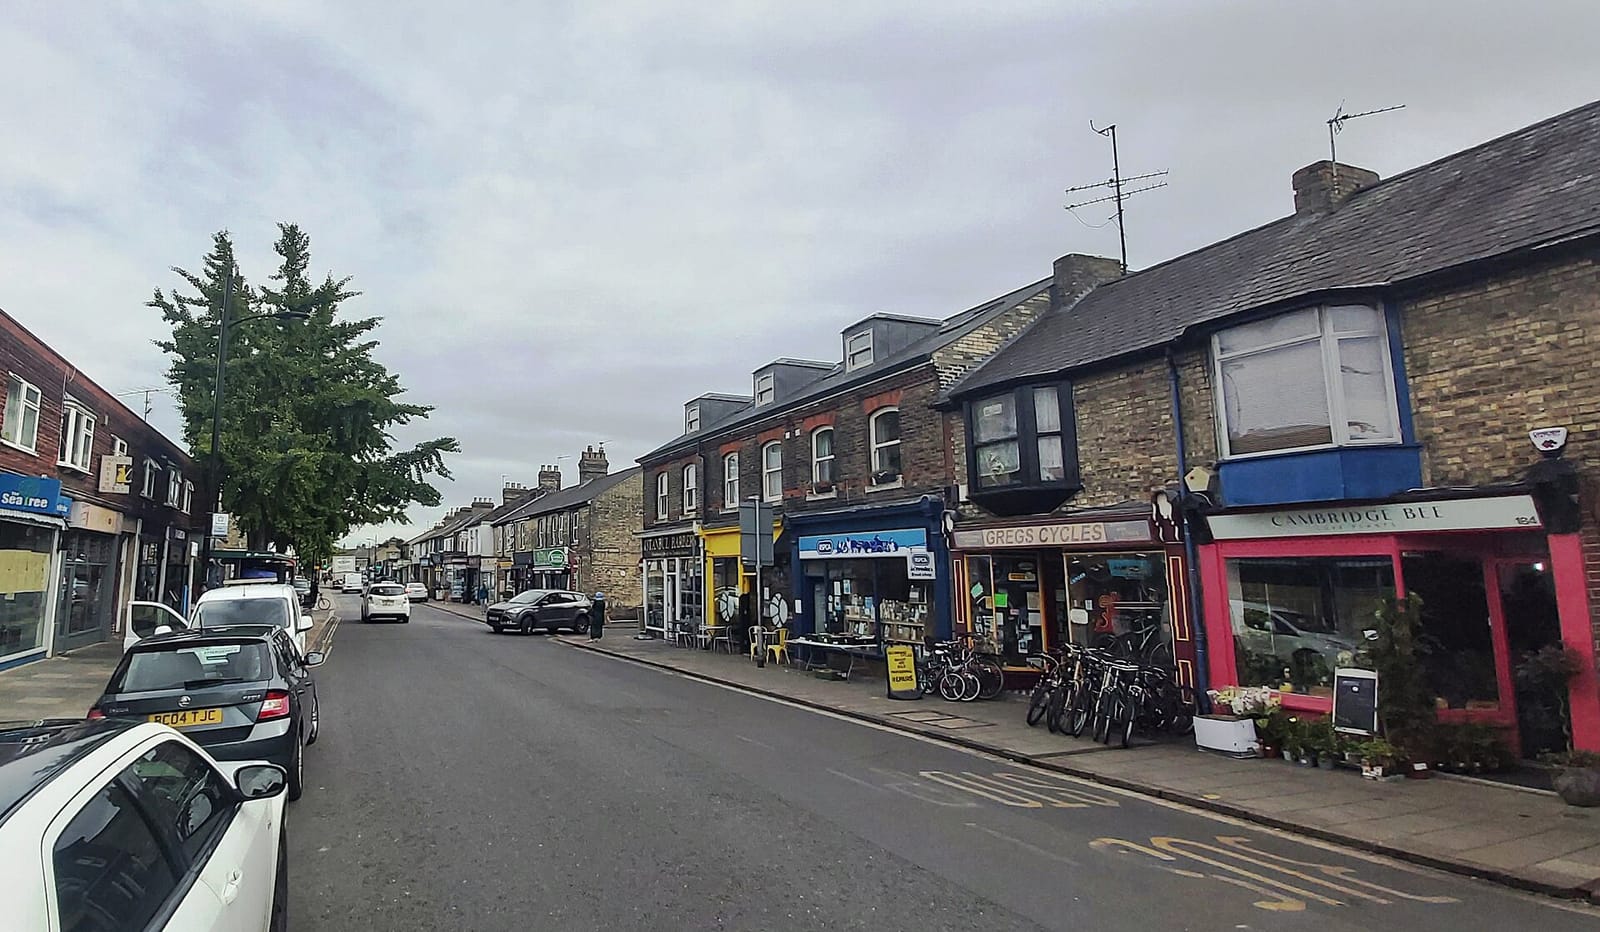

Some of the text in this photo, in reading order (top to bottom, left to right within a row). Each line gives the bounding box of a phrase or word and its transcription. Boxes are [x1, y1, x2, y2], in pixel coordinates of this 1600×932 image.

[1271, 506, 1444, 528] CAMBRIDGE BEE
[1514, 516, 1538, 526] 184
[985, 528, 1034, 545] GREGS
[1038, 524, 1103, 543] CYCLES
[191, 710, 216, 722] TJC
